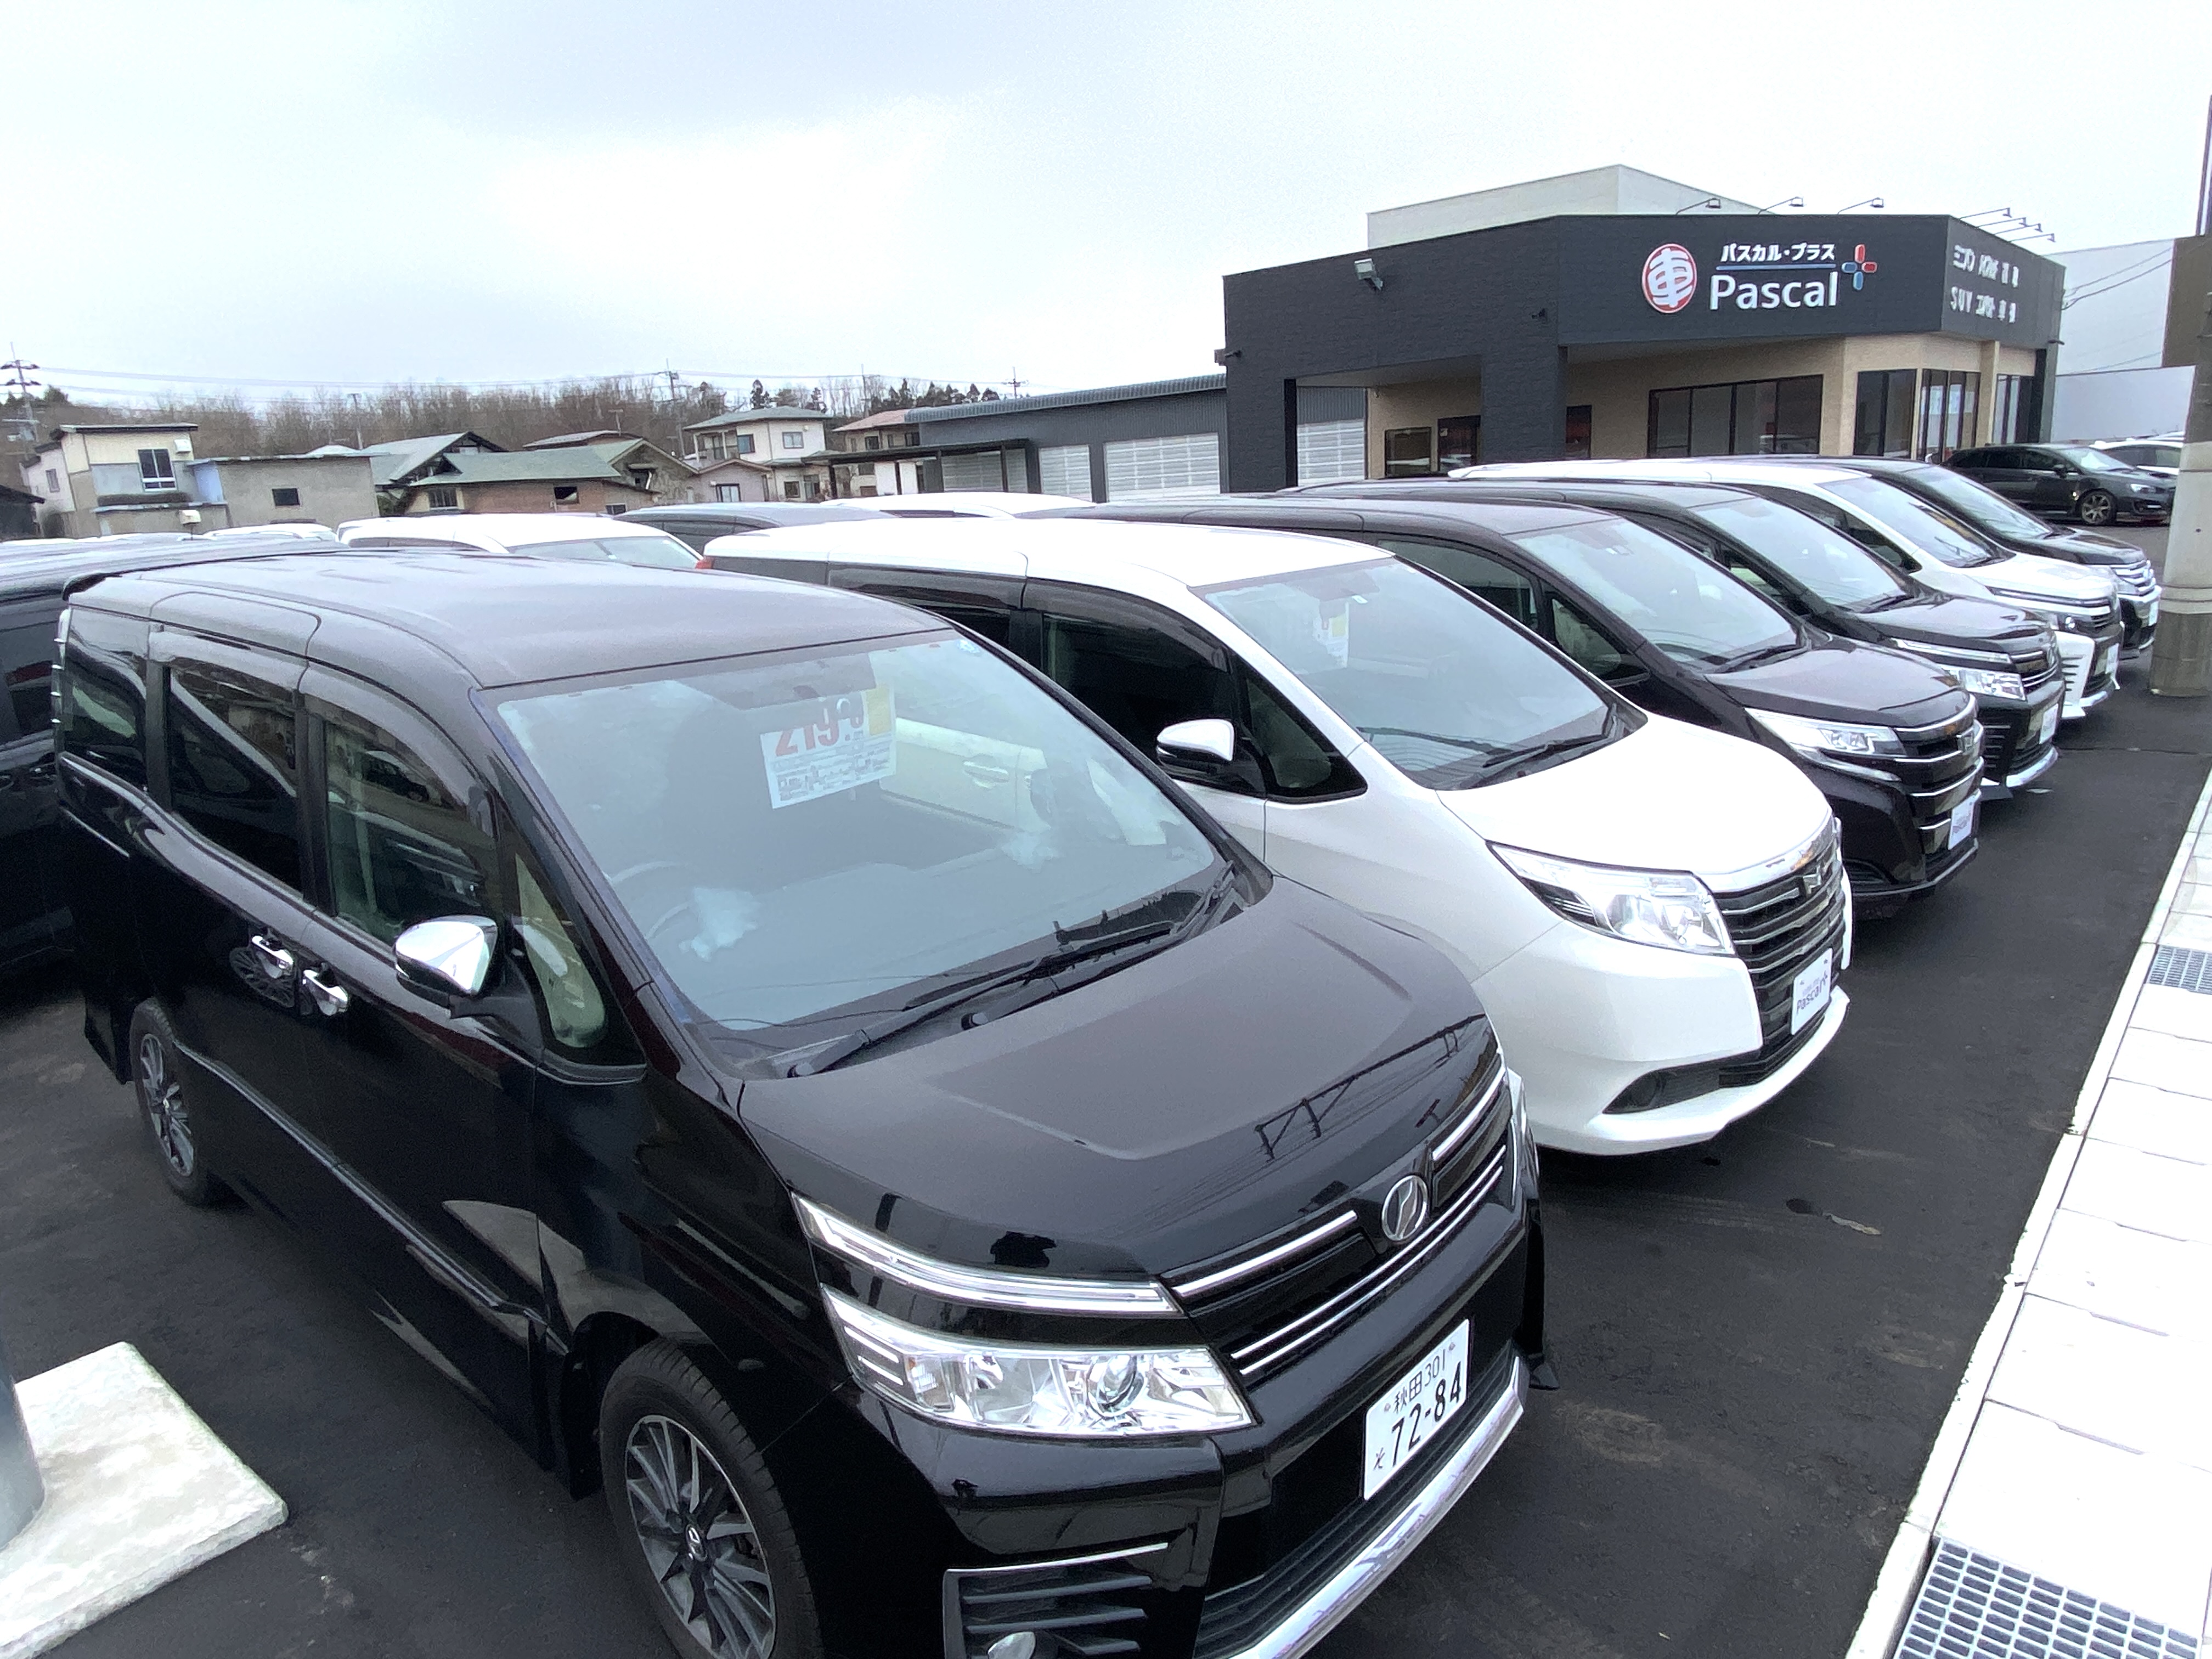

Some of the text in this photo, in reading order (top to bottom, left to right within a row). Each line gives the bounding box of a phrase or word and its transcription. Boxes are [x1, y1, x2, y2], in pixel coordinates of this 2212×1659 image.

[1720, 242, 1835, 262] パスカル・プラス
[1709, 271, 1838, 311] Pascal
[1391, 1361, 1462, 1468] 72-84
